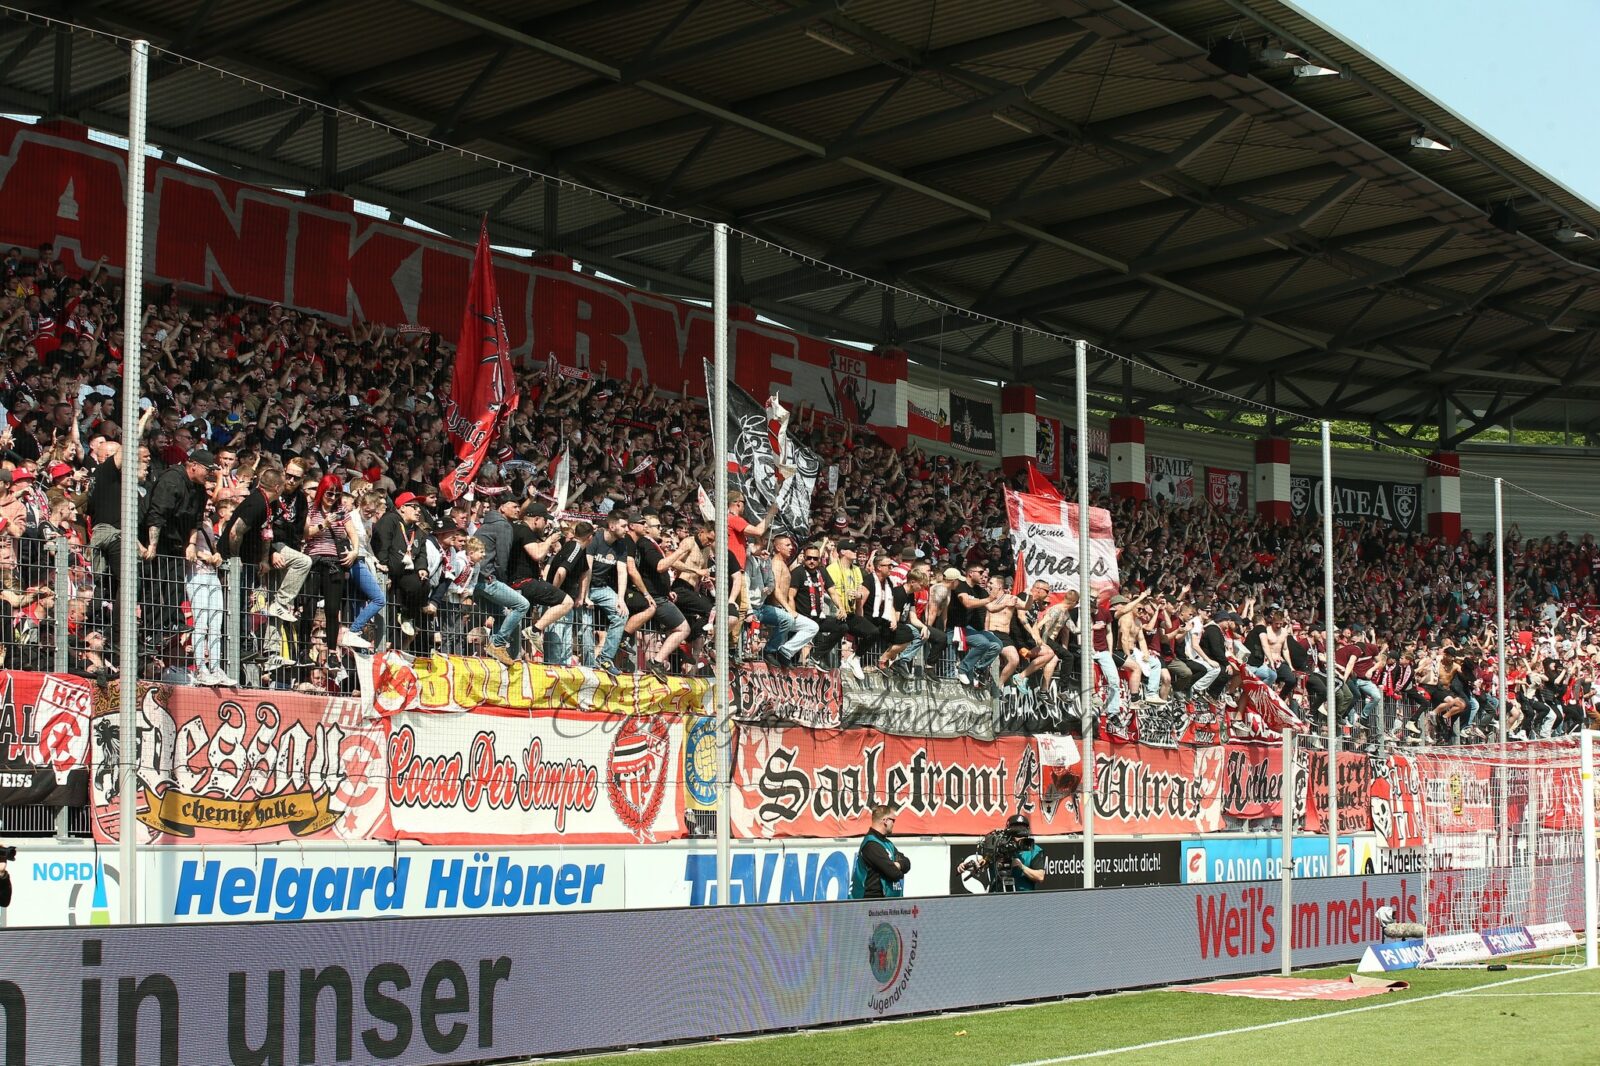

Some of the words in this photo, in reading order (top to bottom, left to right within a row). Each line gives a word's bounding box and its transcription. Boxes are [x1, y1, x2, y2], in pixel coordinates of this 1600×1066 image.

[839, 356, 862, 374] HFC
[1290, 479, 1306, 487] HFC
[1397, 487, 1412, 495] HFC
[1048, 581, 1069, 592] alle
[52, 684, 90, 712] HFC
[0, 773, 33, 788] EISS
[757, 742, 1008, 825] Saalefront
[181, 803, 251, 823] chemie
[1318, 811, 1366, 833] Stdion
[33, 862, 94, 881] NORD
[1113, 853, 1139, 873] sucht
[1140, 852, 1161, 871] dich!
[1214, 857, 1263, 882] RADIO
[1265, 853, 1329, 879] BRCKEN
[174, 857, 411, 921] Helgard
[424, 852, 606, 909] Hübner
[1196, 887, 1275, 960] Weil's
[1326, 880, 1385, 945] mehr
[1382, 948, 1398, 966] PS
[81, 938, 180, 1066] in
[227, 955, 513, 1066] unser
